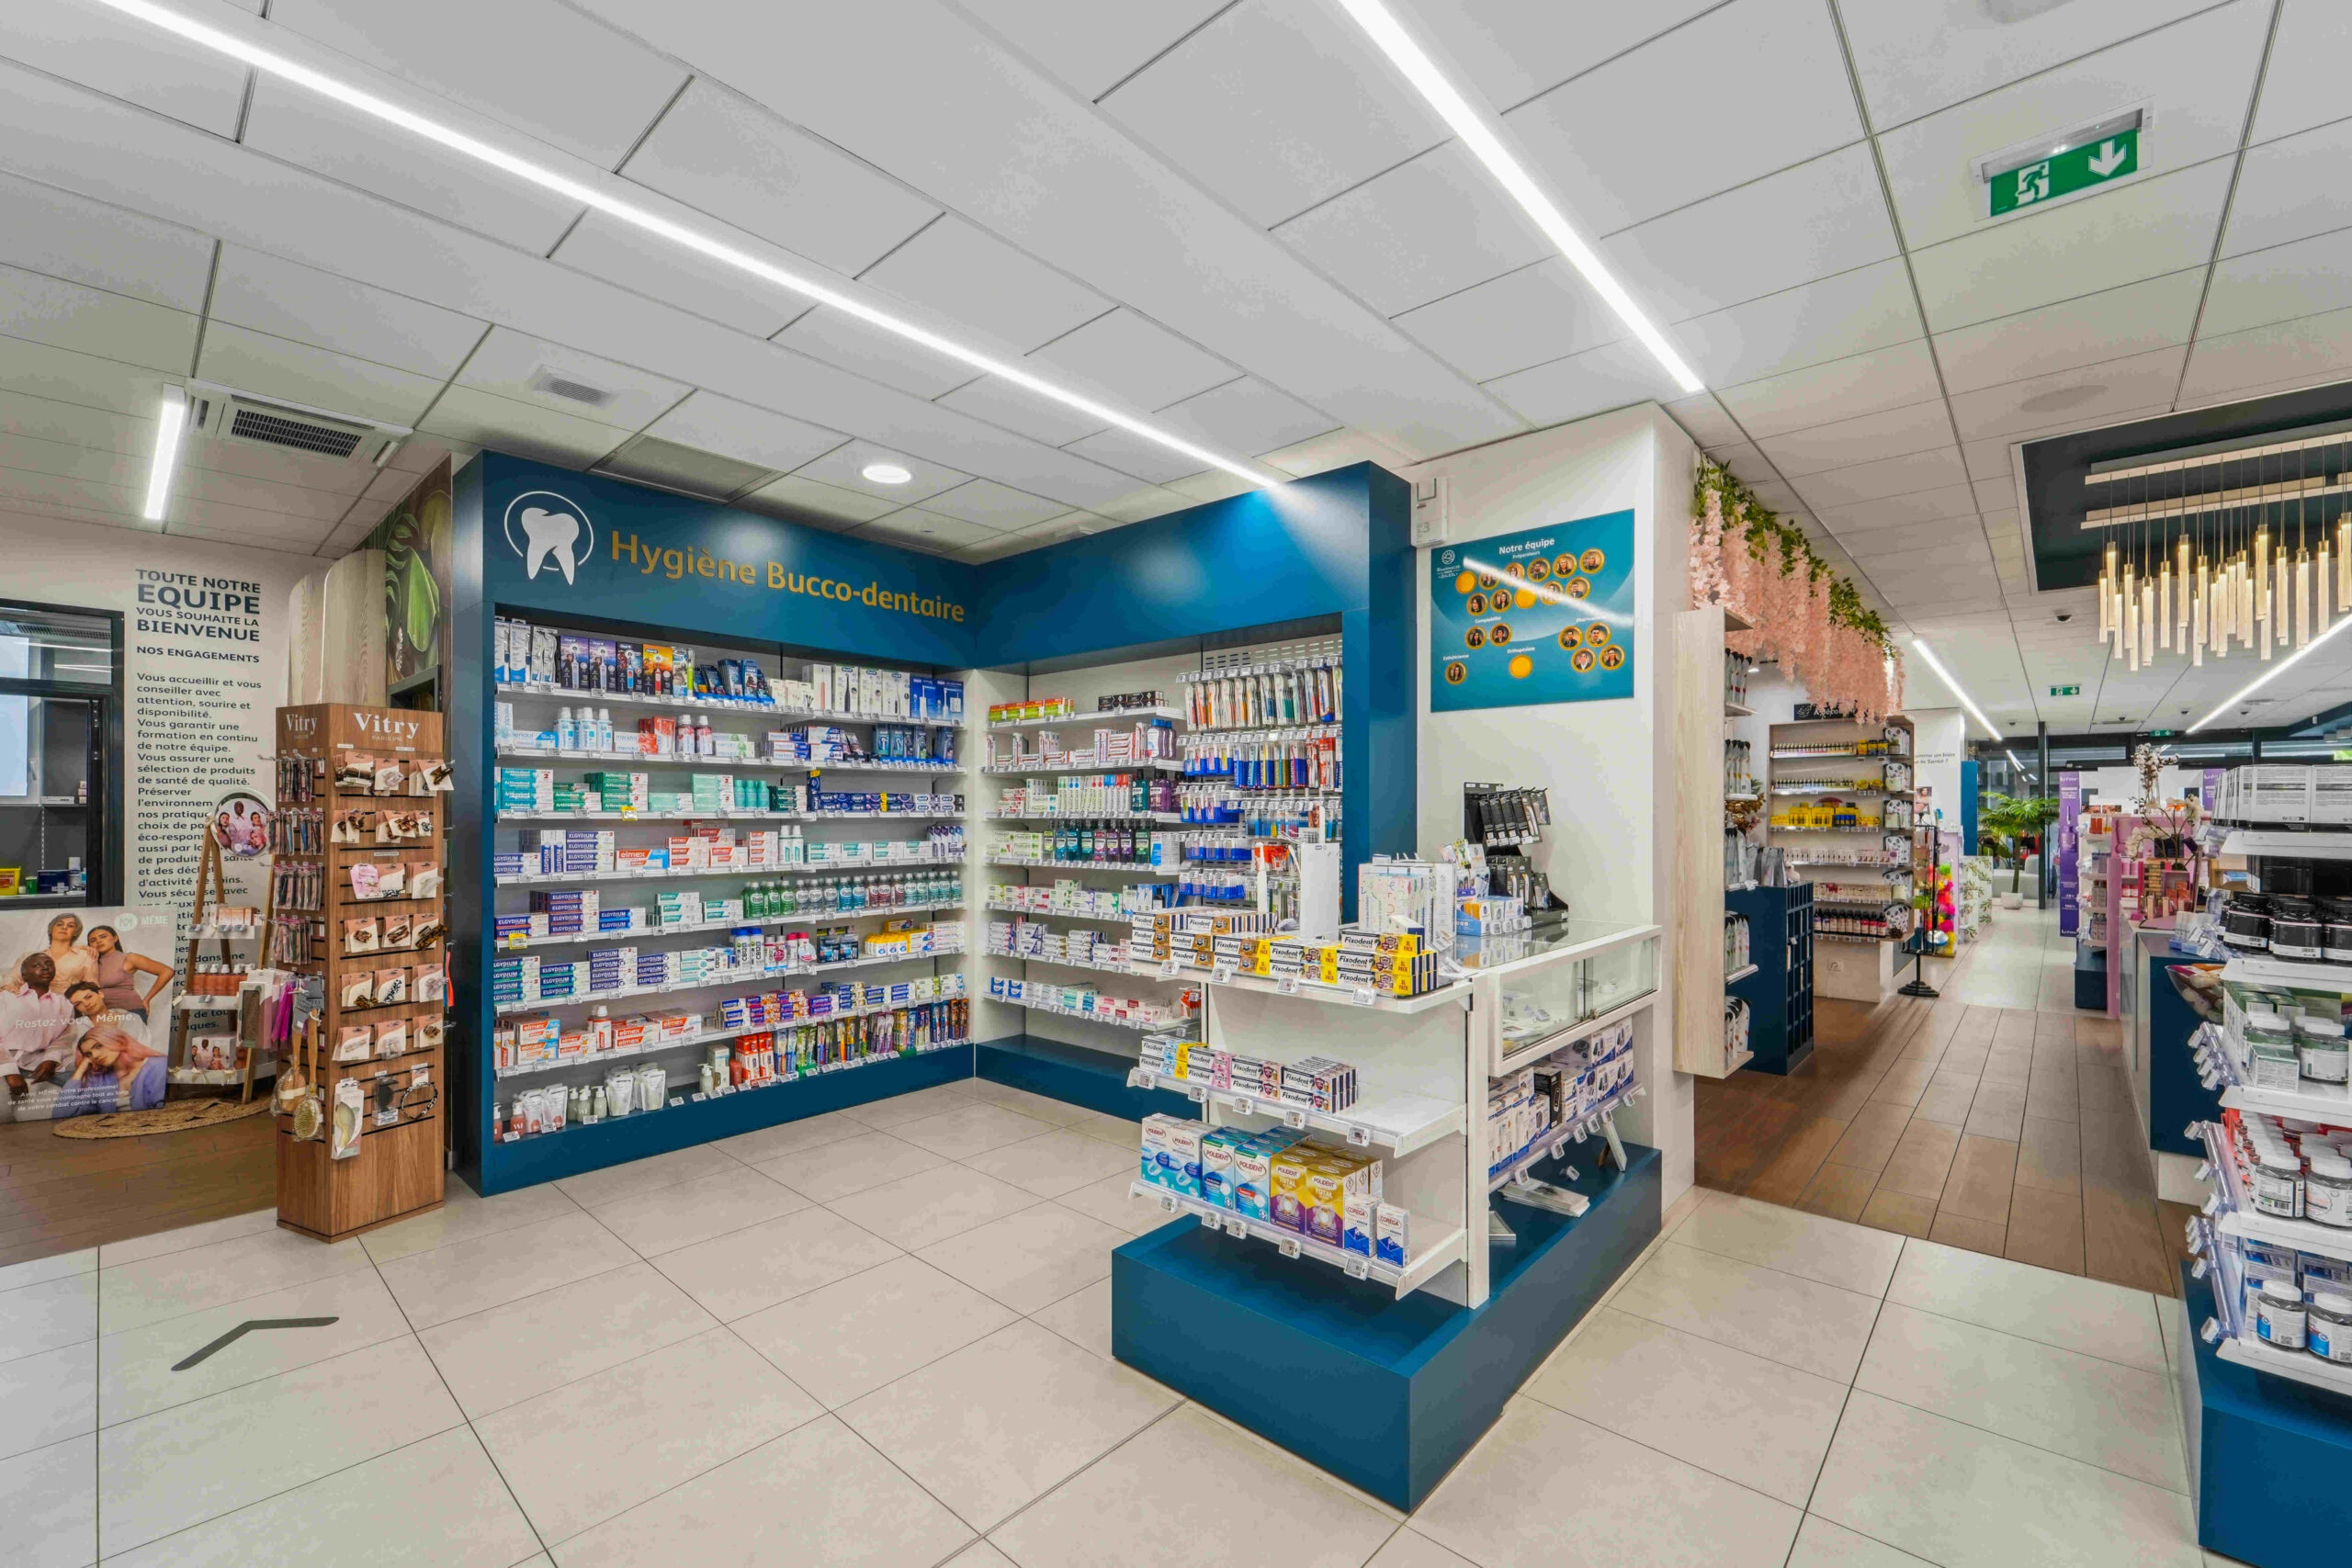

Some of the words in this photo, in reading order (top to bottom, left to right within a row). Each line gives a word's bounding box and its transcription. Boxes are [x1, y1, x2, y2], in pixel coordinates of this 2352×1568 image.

[1498, 544, 1522, 555] Notre
[1525, 537, 1555, 550] équipe
[136, 569, 197, 586] TOUTE
[203, 577, 261, 593] NOTRE
[610, 531, 756, 585] Hygiène
[766, 560, 965, 623] Bucco-dentaire
[138, 583, 260, 615] EQUIPE
[137, 607, 172, 618] VOUS
[176, 612, 241, 625] SOUHAITE
[244, 618, 259, 626] LA
[138, 619, 260, 641] BIENVENUE
[137, 646, 164, 655] NOS
[168, 649, 259, 663] ENGAGEMENTS
[137, 672, 165, 682] Vous
[169, 675, 219, 685] accueillir
[137, 684, 191, 695] conseiller
[138, 697, 196, 707] attention,
[199, 700, 236, 709] sourire
[138, 707, 211, 718] disponibilité.
[138, 719, 165, 728] Vous
[170, 722, 215, 730] garantir
[286, 714, 318, 735] Vitry
[353, 712, 420, 739] Vitry
[138, 730, 196, 739] formation
[217, 733, 257, 742] continu
[190, 740, 231, 753] équipe.
[138, 753, 165, 761] Vous
[138, 765, 189, 773] sélection
[210, 767, 255, 775] produits
[155, 776, 187, 784] santé
[209, 777, 250, 786] qualité.
[139, 787, 191, 795] Préserver
[139, 822, 169, 830] choix
[173, 822, 187, 830] de
[621, 850, 646, 858] elmex
[139, 878, 192, 887] d'activité
[1216, 941, 1238, 949] Fixodent
[1344, 936, 1373, 945] Fixodent
[1272, 947, 1298, 956] Fixodent
[196, 953, 220, 962] dans
[1216, 957, 1238, 965] Fixodent
[1272, 965, 1298, 974] Fixodent
[15, 1019, 56, 1029] Restez
[1148, 1129, 1164, 1137] POLIDENT
[1175, 1137, 1192, 1146] POLIDENT
[1206, 1150, 1229, 1161] POLIDENT
[1239, 1160, 1263, 1172] POLIDENT
[1277, 1167, 1298, 1177] POLIDENT
[1280, 1177, 1295, 1186] TOTAL
[1314, 1178, 1335, 1188] POLIDENT
[1315, 1189, 1332, 1199] TOTAL
[1347, 1206, 1365, 1217] COREGA
[1380, 1216, 1399, 1226] COREGA
